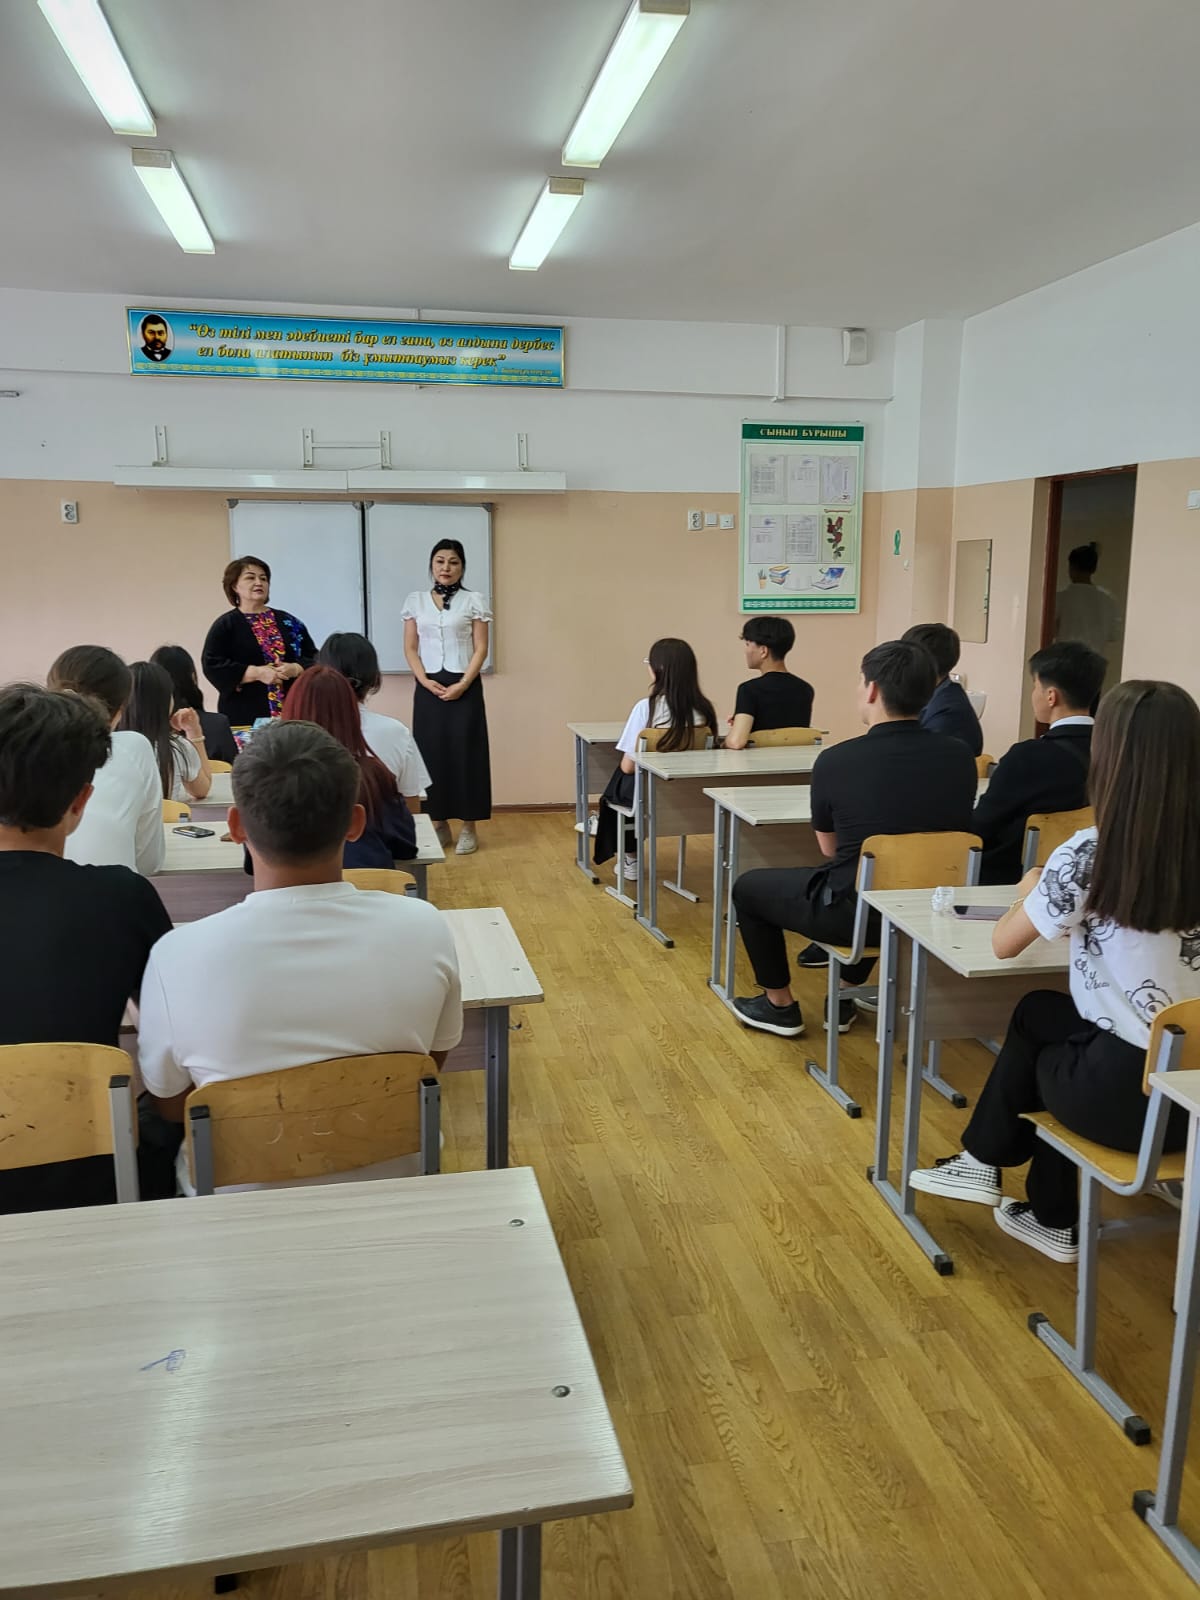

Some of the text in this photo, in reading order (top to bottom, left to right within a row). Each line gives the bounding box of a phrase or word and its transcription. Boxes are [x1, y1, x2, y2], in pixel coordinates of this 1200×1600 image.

[219, 325, 252, 339] тілі
[254, 330, 283, 341] мен
[286, 329, 352, 344] әдебиеті
[354, 331, 379, 348] бар
[381, 335, 398, 346] ел
[456, 336, 508, 350] алдына
[510, 337, 556, 354] дербес
[197, 346, 214, 357] ел
[217, 344, 251, 359] бола
[254, 348, 334, 361] алатынын
[341, 349, 361, 363] біз
[459, 353, 507, 369] керек”
[760, 428, 798, 437] СЫНЫП
